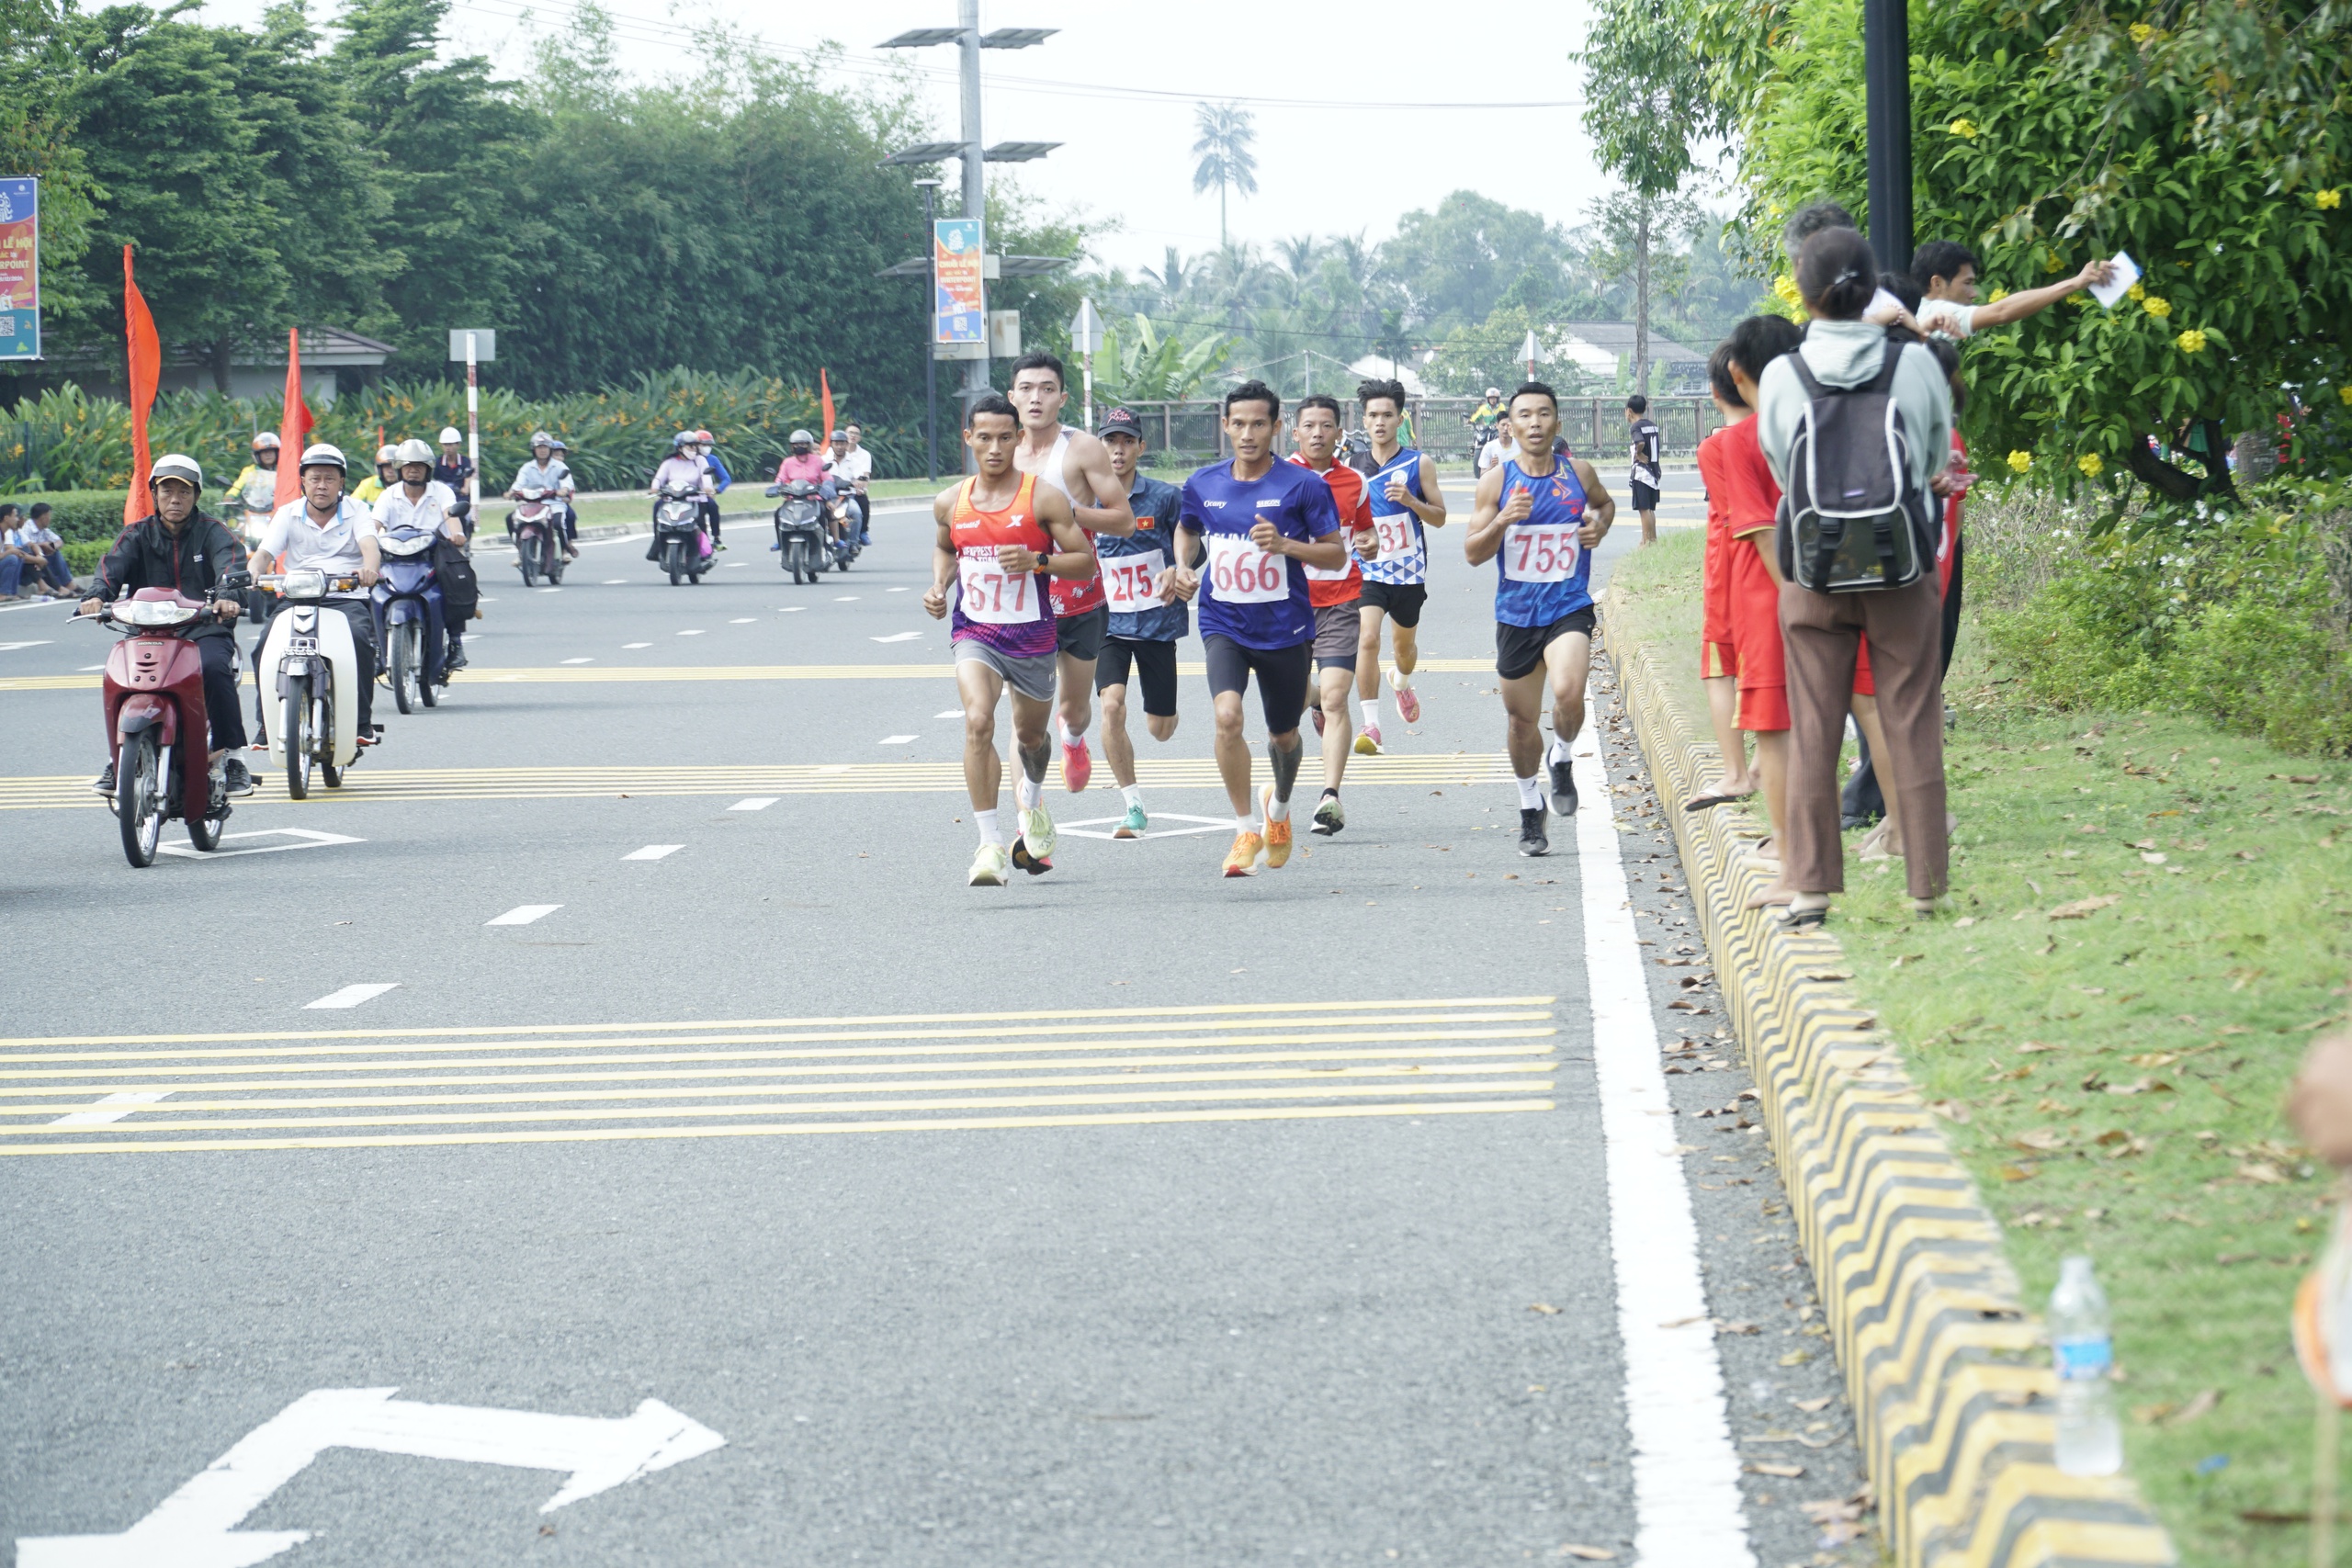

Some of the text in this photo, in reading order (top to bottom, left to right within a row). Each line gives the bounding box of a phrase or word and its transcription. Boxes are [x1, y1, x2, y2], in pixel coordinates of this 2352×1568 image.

[1256, 499, 1281, 508] SAIGON
[1214, 550, 1281, 593] 666
[1514, 532, 1577, 574] 755
[967, 572, 1026, 612] 677
[1111, 563, 1153, 602] 275
